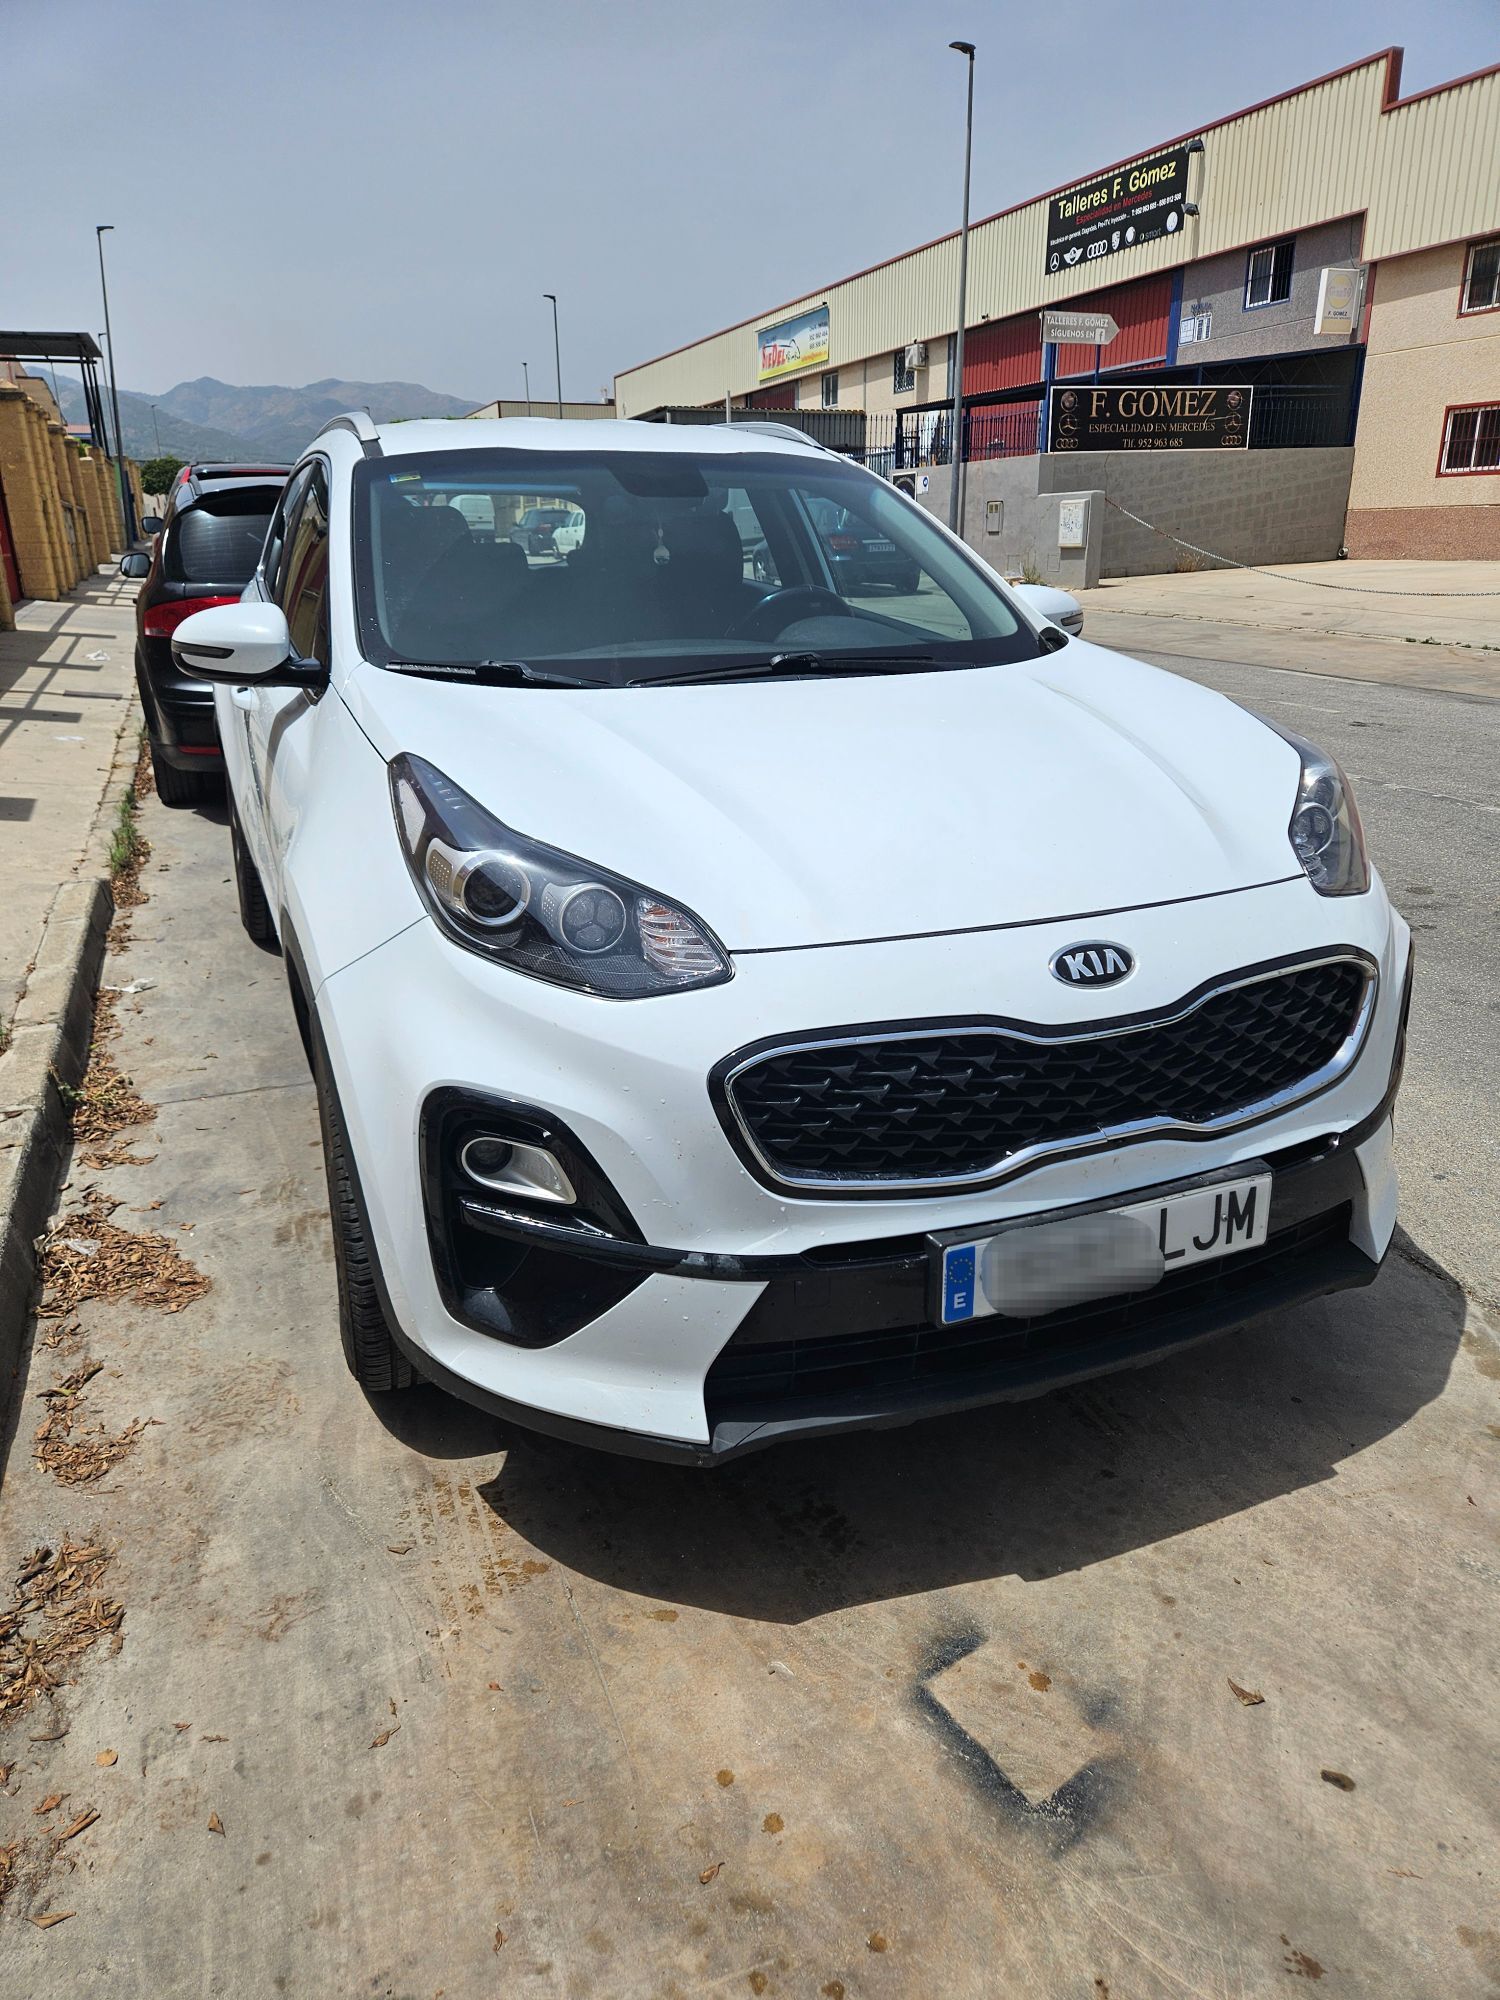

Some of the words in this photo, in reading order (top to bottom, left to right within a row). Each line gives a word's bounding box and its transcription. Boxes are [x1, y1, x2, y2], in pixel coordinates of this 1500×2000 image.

[1058, 188, 1108, 220] Talleres
[1112, 178, 1124, 199] F.
[1129, 161, 1176, 192] Gómez
[1123, 190, 1152, 207] Mercedes
[1145, 228, 1161, 240] smart
[1047, 315, 1077, 326] TALLERES
[1078, 318, 1084, 326] F.
[1085, 317, 1108, 327] GÓMEZ
[1051, 328, 1085, 338] SÍGUENOS
[1086, 330, 1095, 338] EN
[1089, 391, 1110, 418] F.
[1118, 390, 1217, 418] GOMEZ
[1088, 423, 1153, 433] ESPECIALIDAD
[1155, 423, 1167, 432] EN
[1169, 422, 1216, 432] MERCEDES
[1138, 438, 1152, 448] 952
[1154, 438, 1168, 447] 963
[1169, 438, 1183, 447] 685
[1063, 948, 1127, 980] KIA
[1159, 1186, 1258, 1261] LJM
[953, 1292, 967, 1309] E
